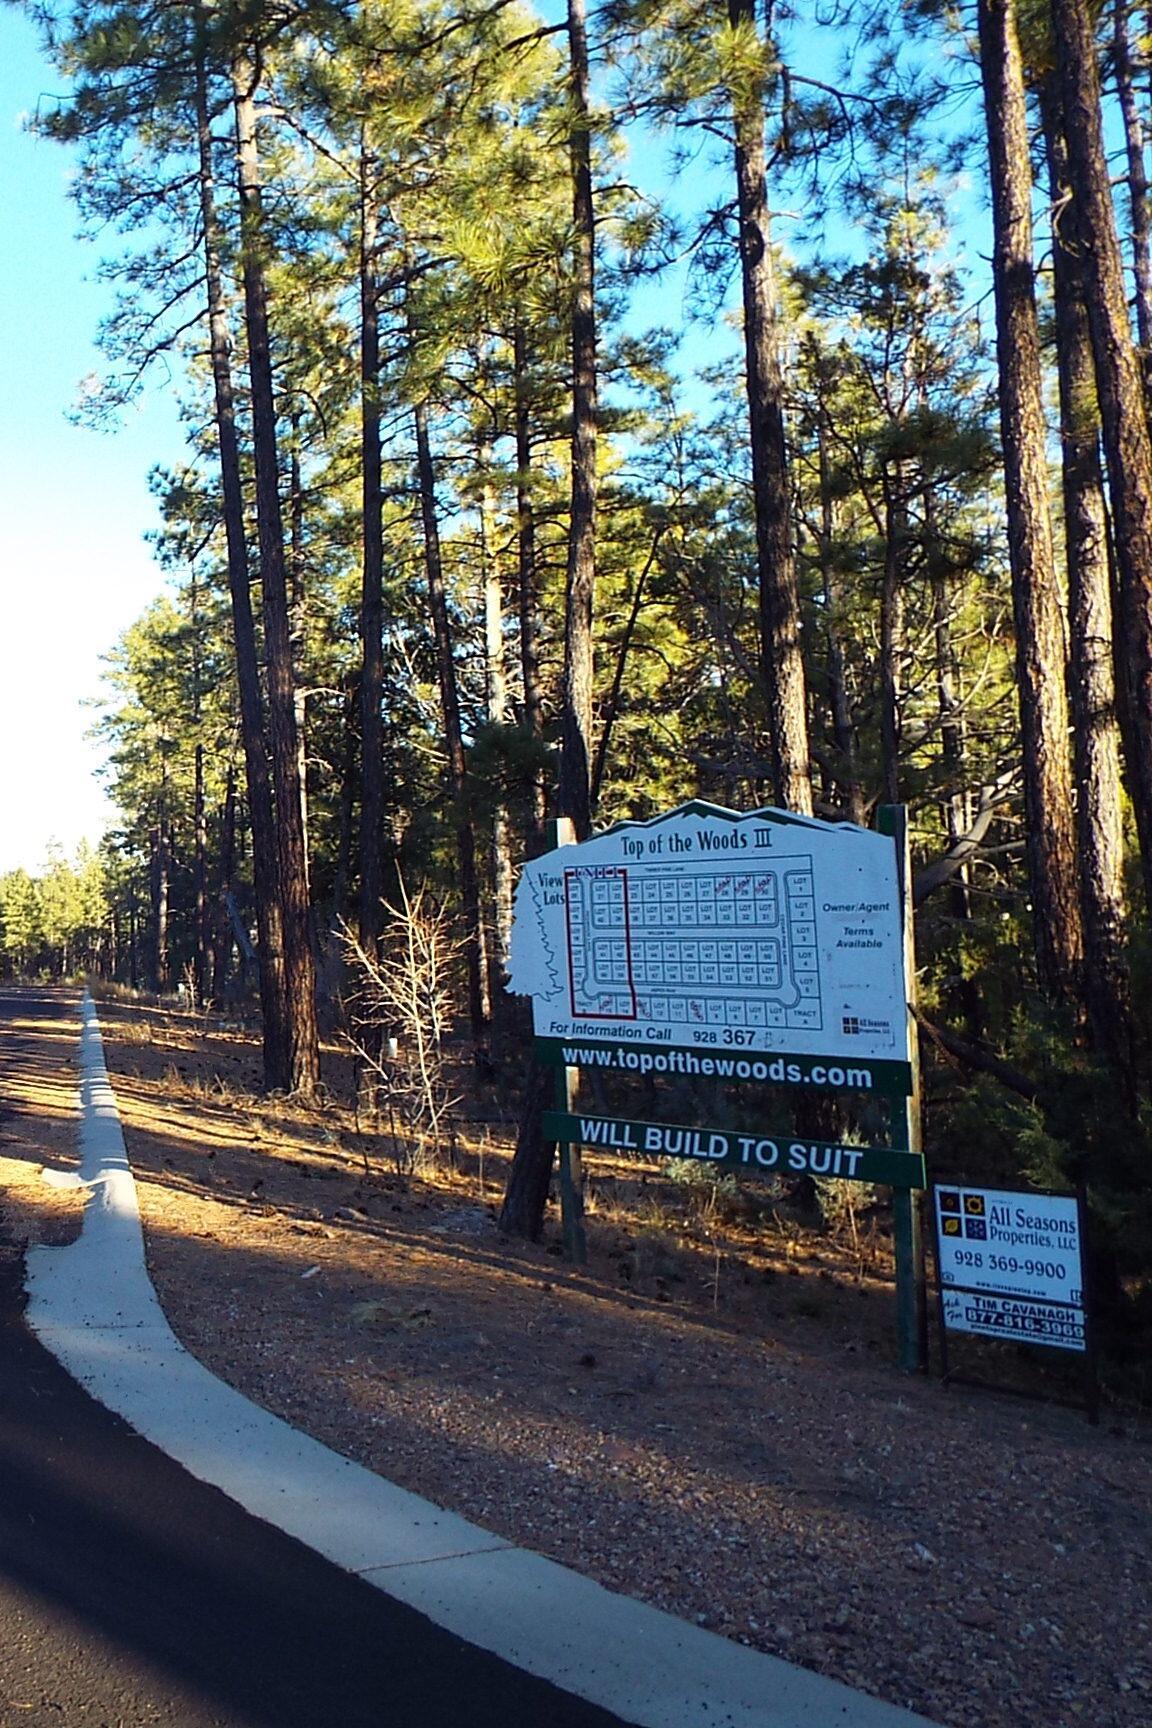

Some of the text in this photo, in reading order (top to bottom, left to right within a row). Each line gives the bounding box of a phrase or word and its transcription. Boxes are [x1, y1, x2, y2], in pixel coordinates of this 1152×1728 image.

[621, 828, 772, 859] Top of the Woods III
[538, 873, 563, 887] View
[543, 891, 565, 905] Lots
[822, 902, 890, 914] Owner/Agent
[836, 939, 883, 949] Available
[843, 927, 874, 936] Terms
[550, 1021, 756, 1046] For Information Call 928 367
[562, 1047, 873, 1088] www.topofthewoods.com
[580, 1119, 863, 1176] WILL BUILD TO SUIT
[989, 1206, 1076, 1234] All Seasons
[990, 1225, 1077, 1251] Properties, LLC
[954, 1250, 1066, 1280] 928 369-9900
[973, 1296, 1076, 1323] TIM CAVANAGH
[967, 1309, 1084, 1338] 877-816-3969
